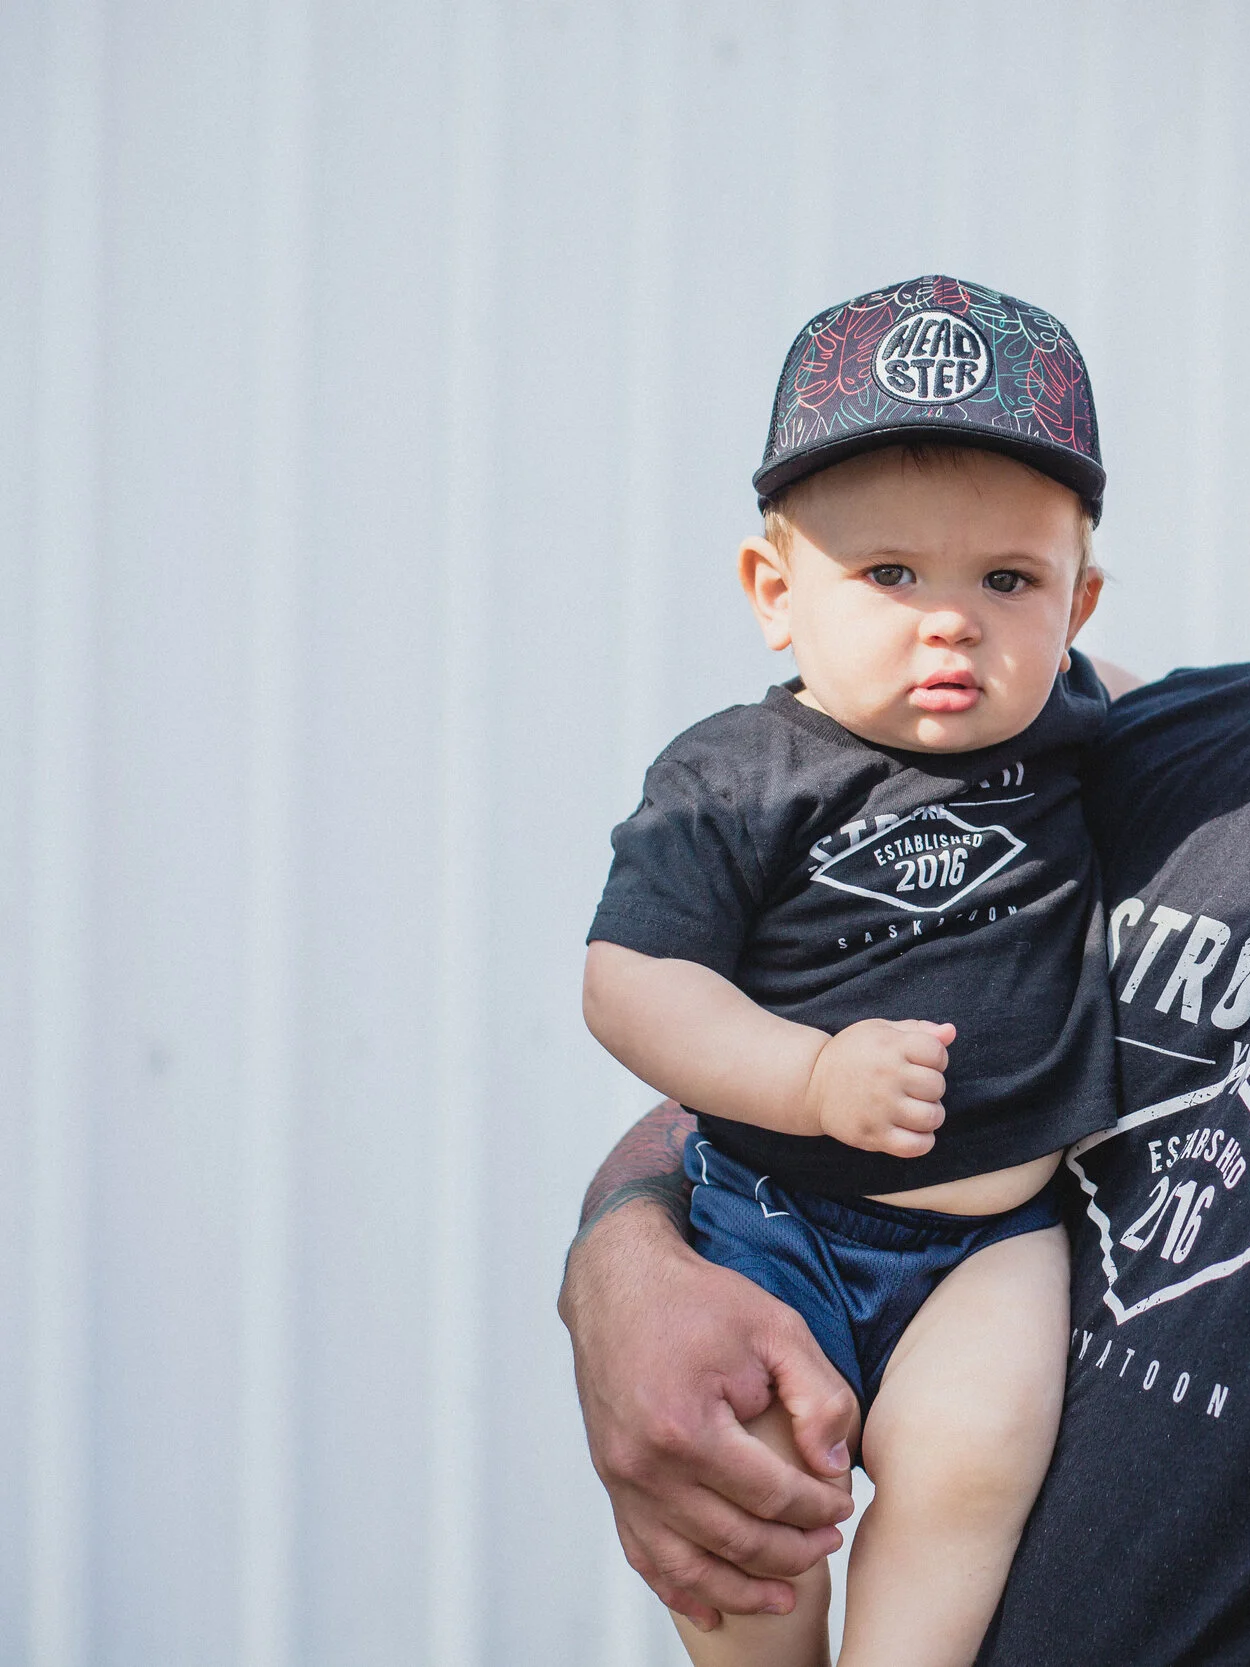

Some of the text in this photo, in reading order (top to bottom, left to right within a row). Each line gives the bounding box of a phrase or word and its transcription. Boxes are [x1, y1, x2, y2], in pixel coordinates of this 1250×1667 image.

[881, 316, 981, 361] HEAD
[884, 358, 979, 399] STER
[873, 833, 983, 867] ESTABLISHED
[894, 848, 969, 892] 2016
